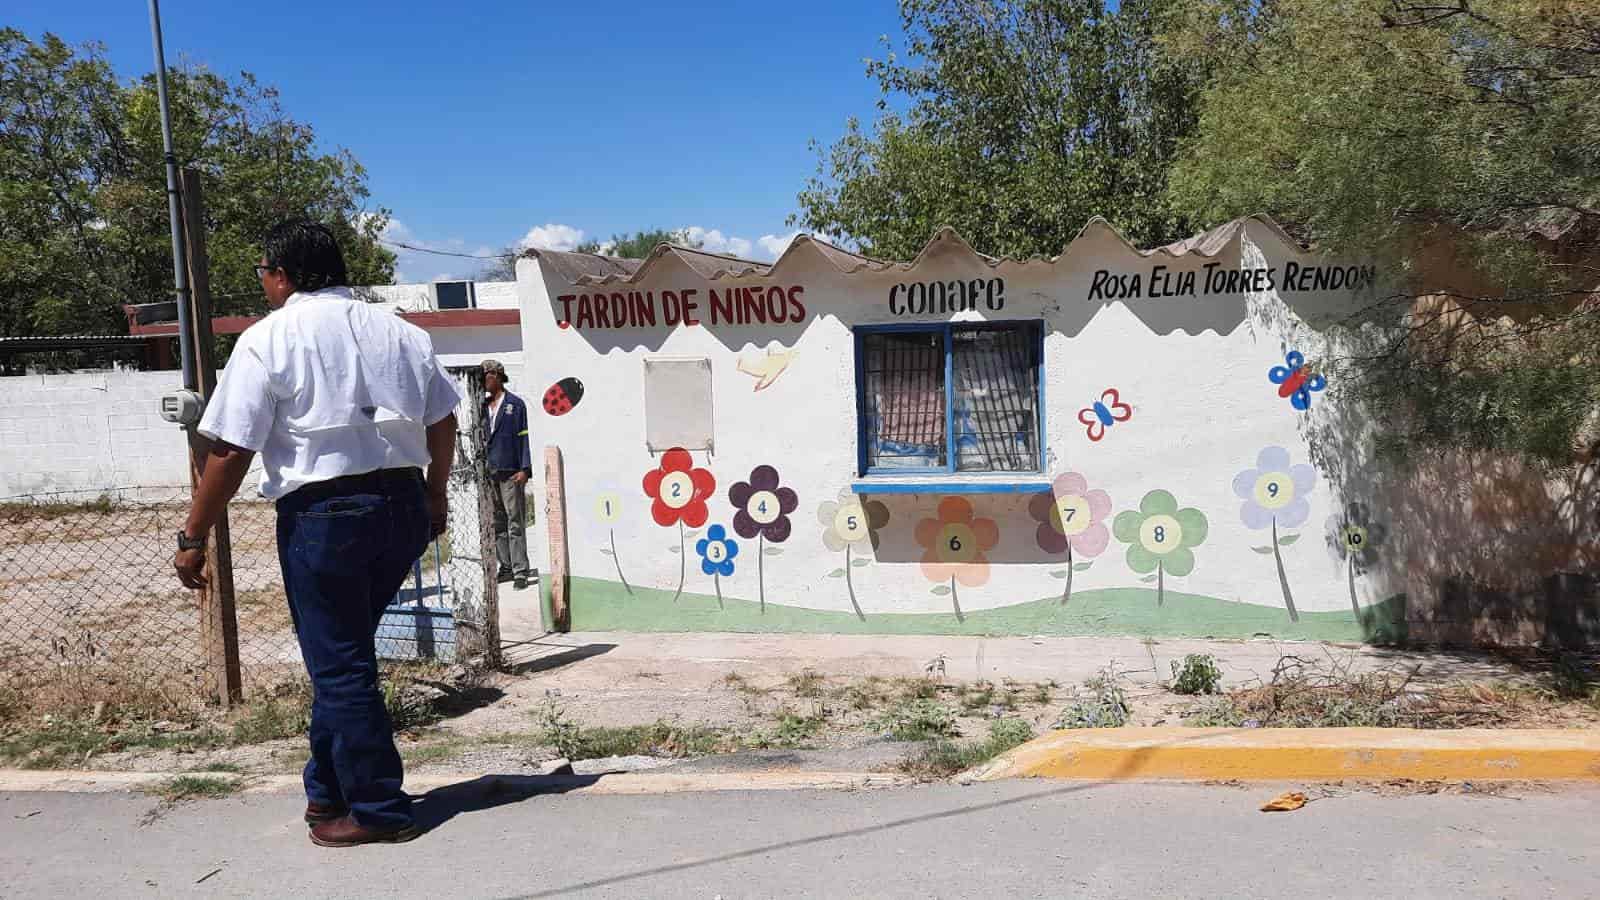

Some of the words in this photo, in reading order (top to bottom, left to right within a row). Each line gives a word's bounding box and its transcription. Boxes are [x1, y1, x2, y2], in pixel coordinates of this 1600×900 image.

[1087, 269, 1142, 300] ROSA
[1202, 262, 1277, 295] TORRES
[557, 291, 657, 330] JARDIN
[662, 289, 700, 326] DE
[709, 286, 806, 325] NIÑOS
[671, 482, 681, 498] 2
[1267, 482, 1279, 498] 9
[605, 500, 611, 517] 1
[757, 500, 768, 515] 4
[1063, 508, 1076, 523] 7
[847, 515, 858, 531] 5
[1153, 525, 1165, 543] 8
[1347, 533, 1362, 546] 10
[949, 535, 961, 551] 6
[713, 546, 721, 559] 3
